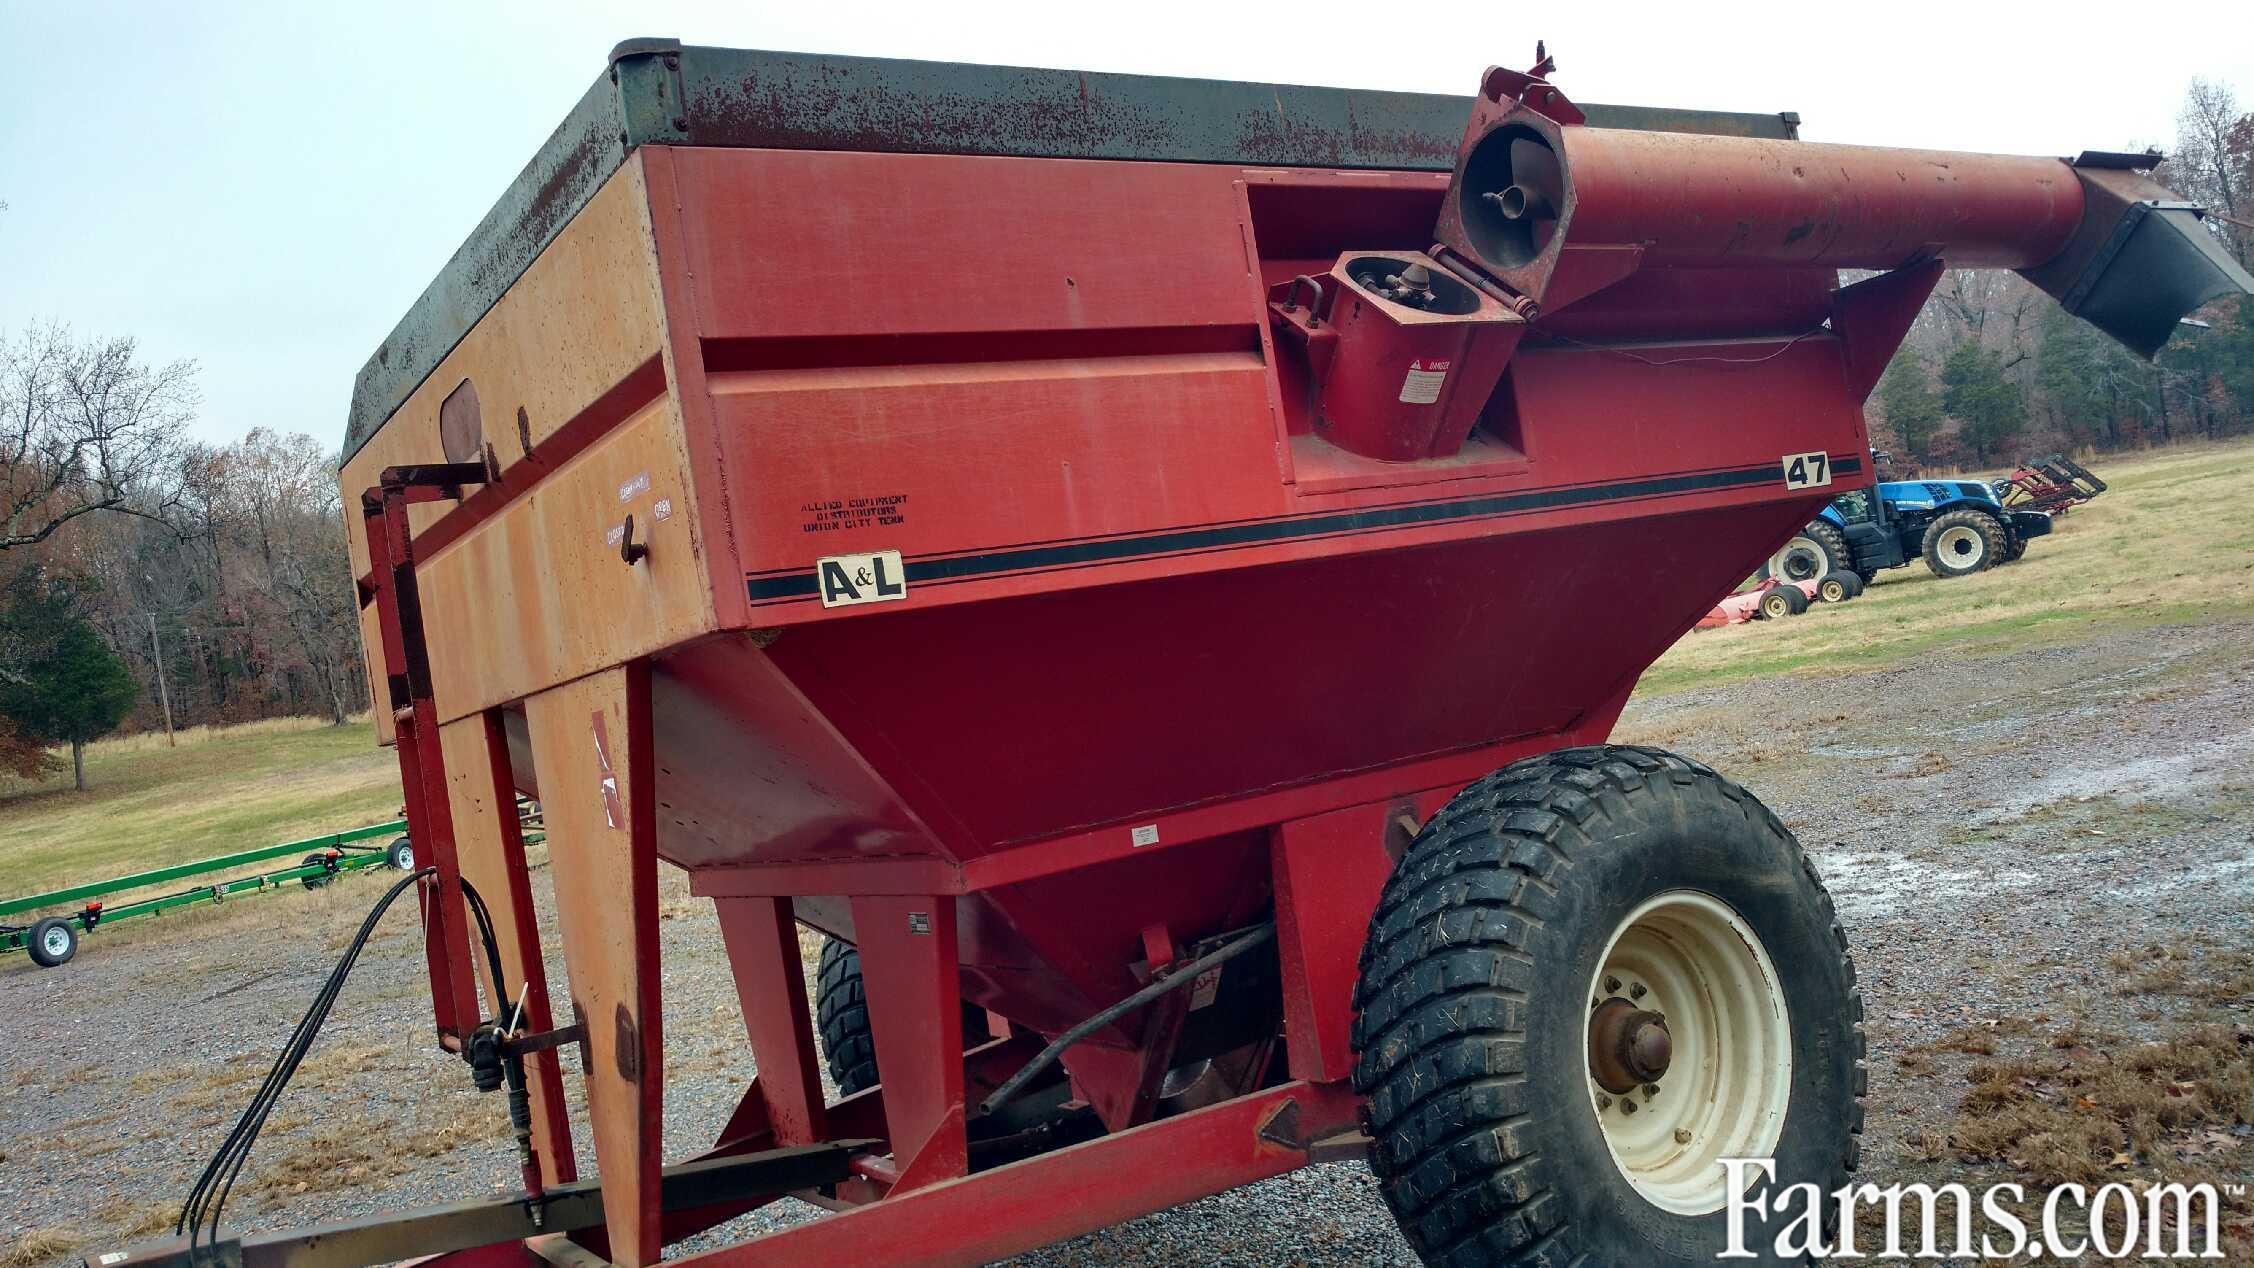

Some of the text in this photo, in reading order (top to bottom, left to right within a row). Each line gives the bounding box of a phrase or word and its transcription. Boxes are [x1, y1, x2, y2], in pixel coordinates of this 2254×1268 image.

[1787, 454, 1826, 485] 47
[654, 499, 671, 515] OPEN
[801, 494, 908, 512] ALLIED EQUIPMENT
[816, 505, 897, 521] DISTRIBUTORS
[803, 515, 905, 533] UNION CITY TENN
[821, 556, 902, 603] A&L
